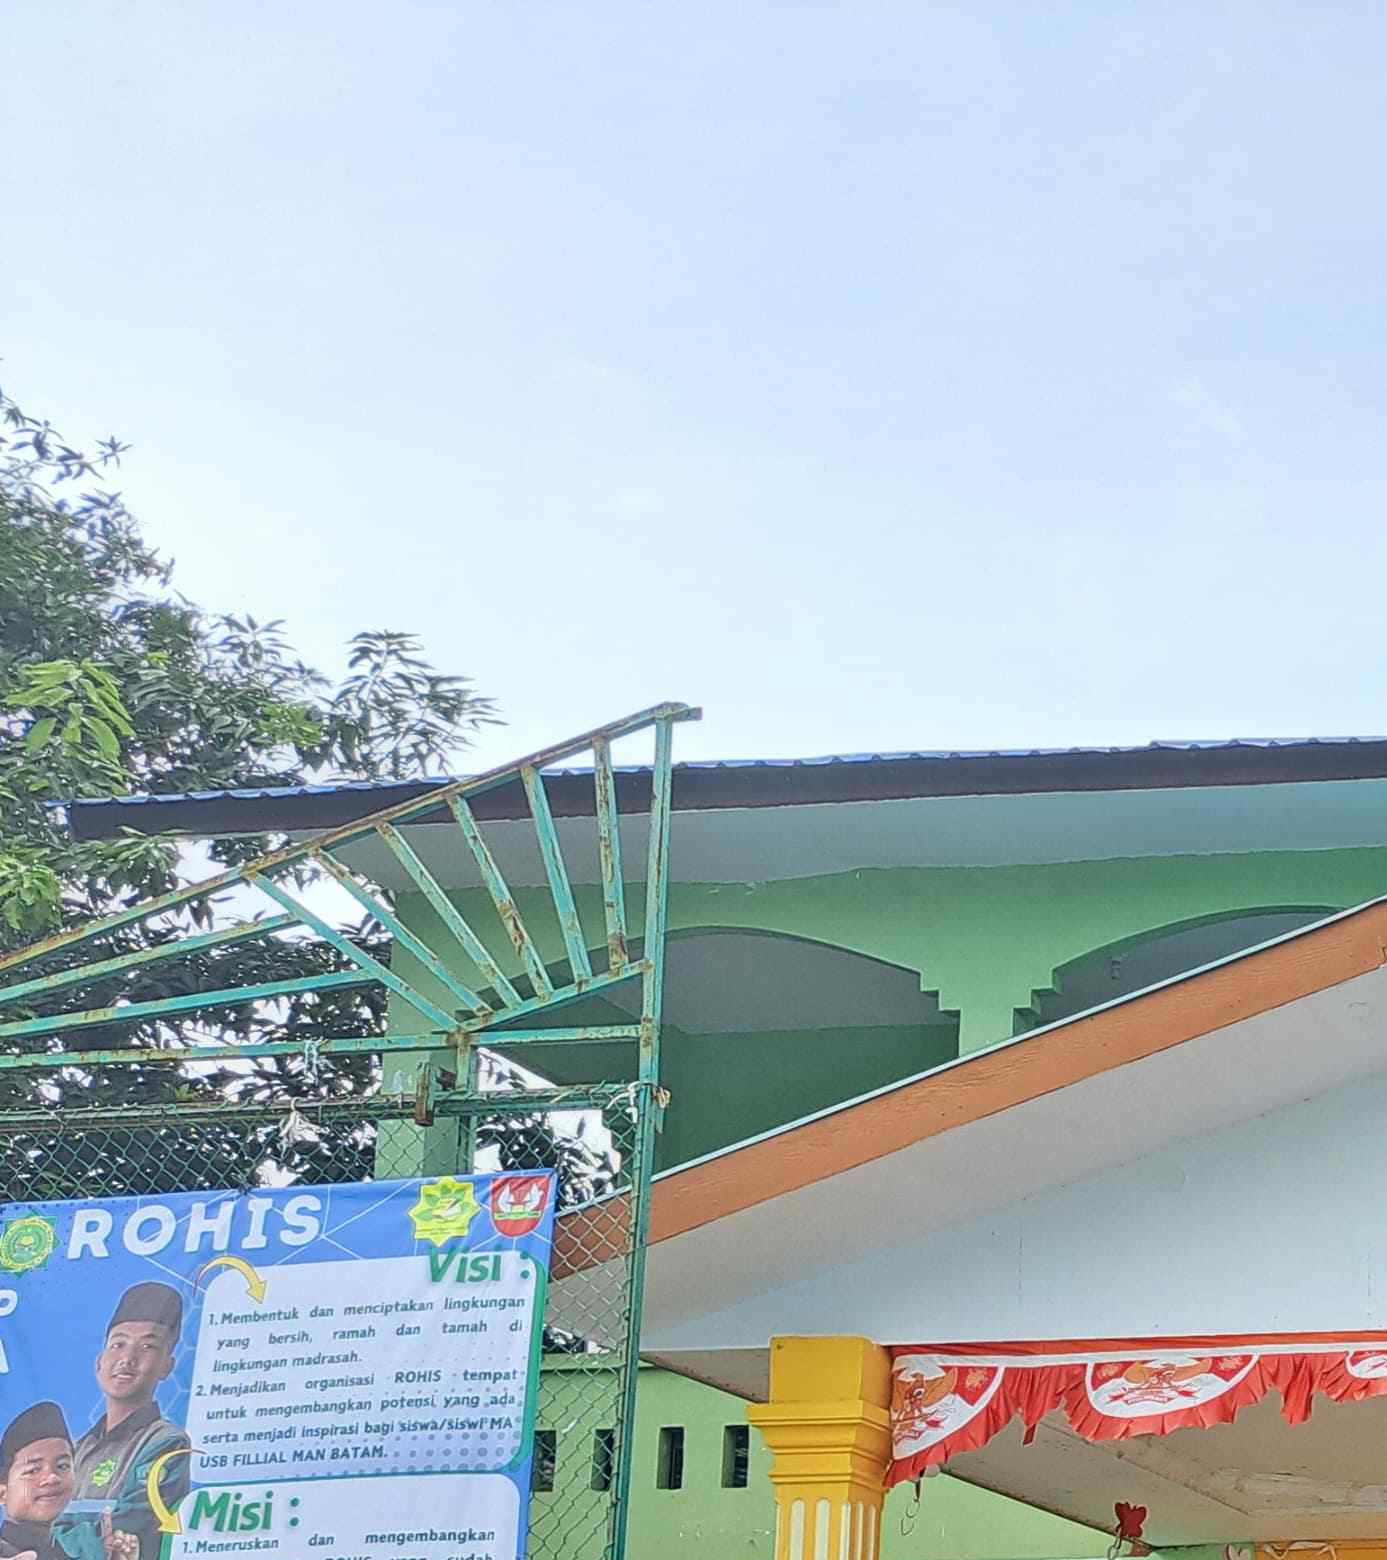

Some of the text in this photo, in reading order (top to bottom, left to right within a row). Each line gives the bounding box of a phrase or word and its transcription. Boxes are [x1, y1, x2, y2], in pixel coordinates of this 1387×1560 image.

[67, 1194, 322, 1261] ROHIS
[427, 1247, 501, 1283] Visi
[310, 1306, 333, 1318] dan
[344, 1301, 433, 1316] menciptakan
[444, 1297, 524, 1312] lingkungan
[214, 1353, 362, 1373] lingkungan madrasah.
[200, 1456, 227, 1468] USB
[233, 1452, 287, 1466] FILLIAL
[292, 1449, 325, 1461] MAN
[188, 1491, 274, 1532] Misi
